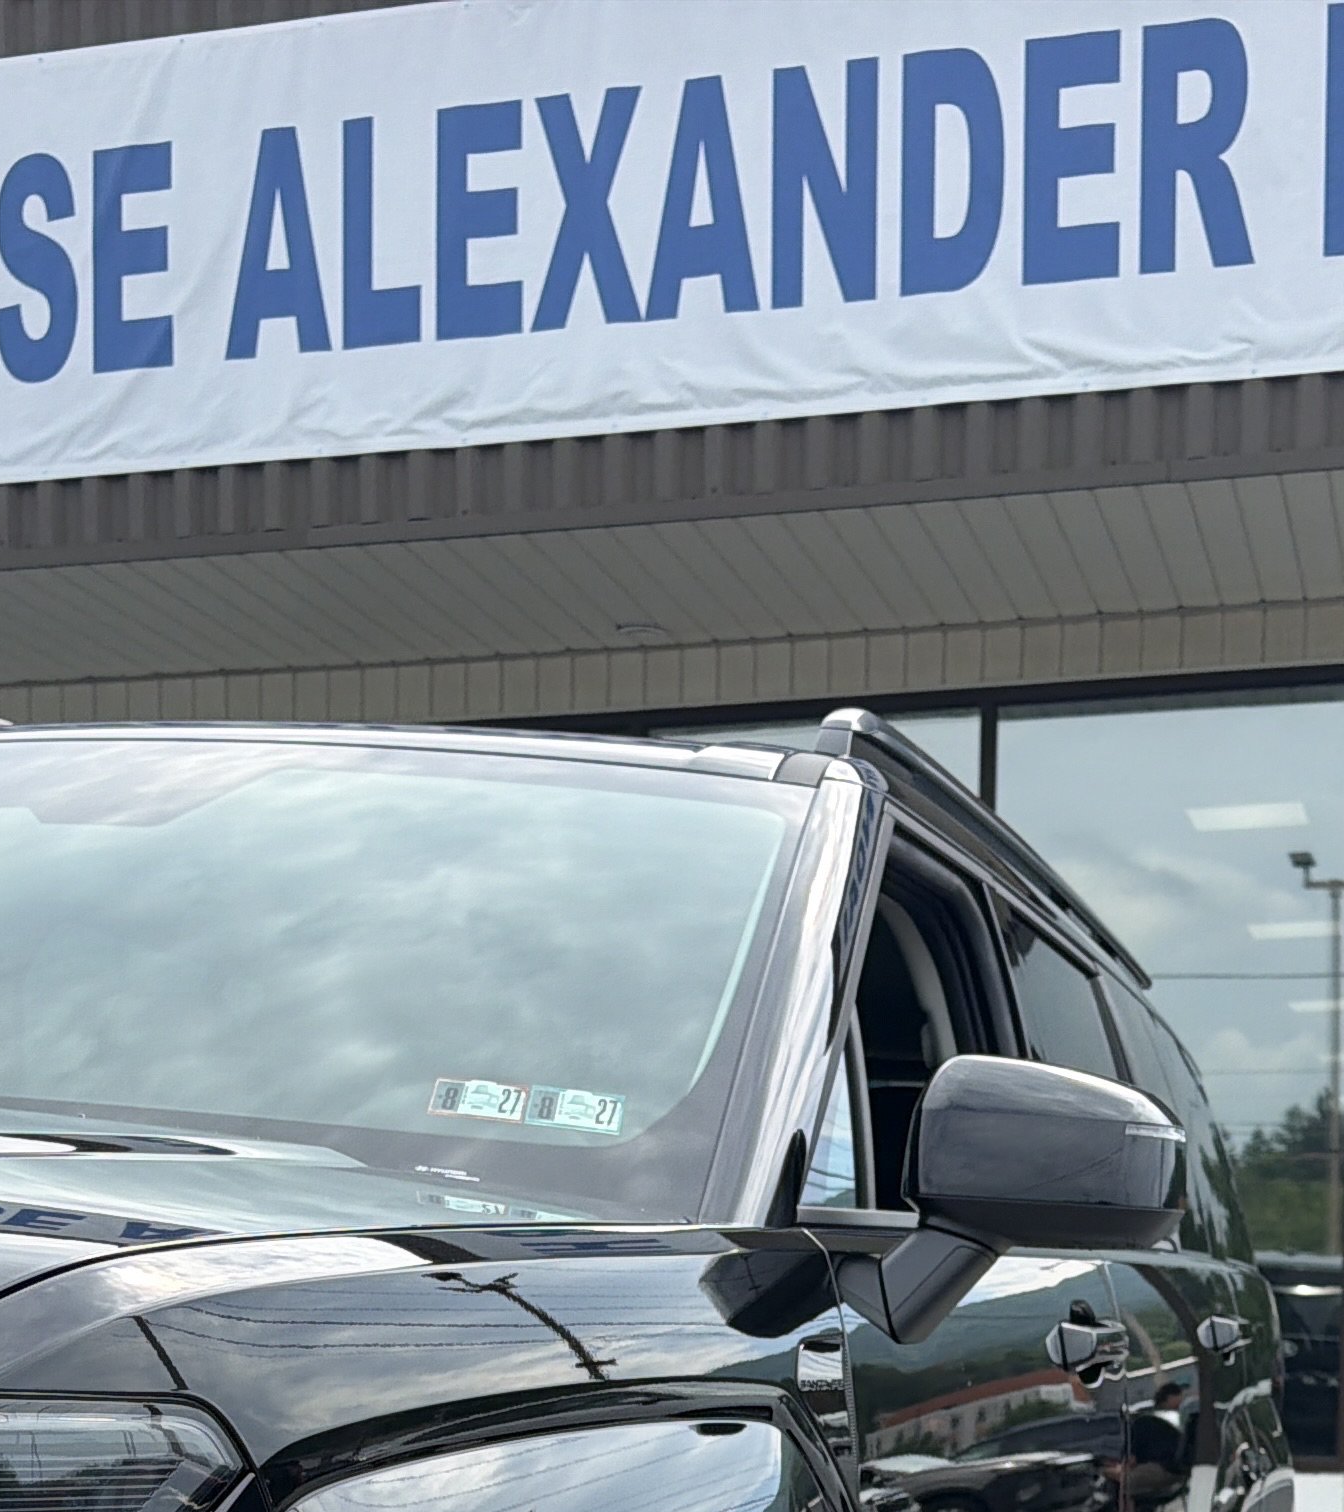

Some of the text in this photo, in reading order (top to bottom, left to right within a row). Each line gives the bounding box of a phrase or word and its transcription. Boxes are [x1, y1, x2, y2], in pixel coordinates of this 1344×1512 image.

[224, 15, 1256, 362] ALEXANDER
[497, 1088, 522, 1117] 27
[595, 1099, 618, 1126] 27
